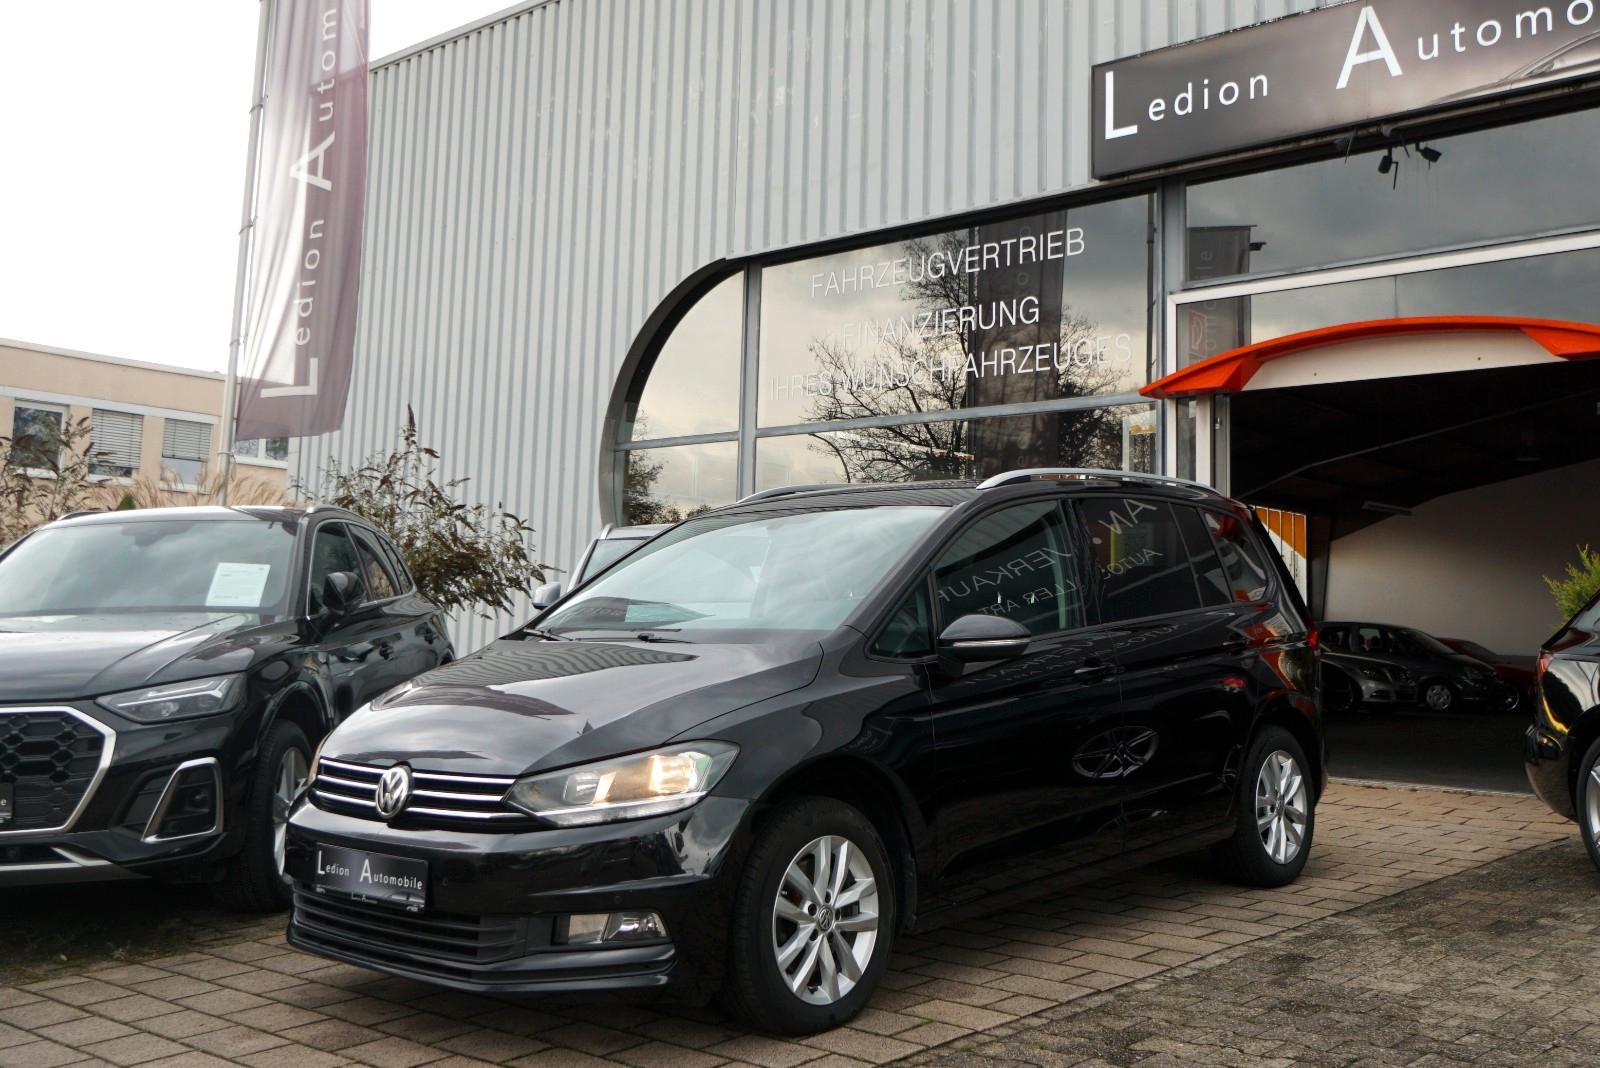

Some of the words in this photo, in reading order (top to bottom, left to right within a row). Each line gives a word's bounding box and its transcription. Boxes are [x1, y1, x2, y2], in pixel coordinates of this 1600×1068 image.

[289, 7, 337, 192] Autom
[1105, 71, 1268, 140] Ledion
[1336, 0, 1594, 90] Automo
[811, 227, 1085, 298] FAHRZEUGVERTRIEB
[260, 219, 324, 398] Ledion
[842, 296, 1039, 348] FINANZIERUNG
[770, 370, 833, 401] IHRES
[842, 333, 1132, 392] WUNSCHFAHRZEUGES
[317, 850, 350, 877] Ledion
[360, 858, 423, 890] Automobile
